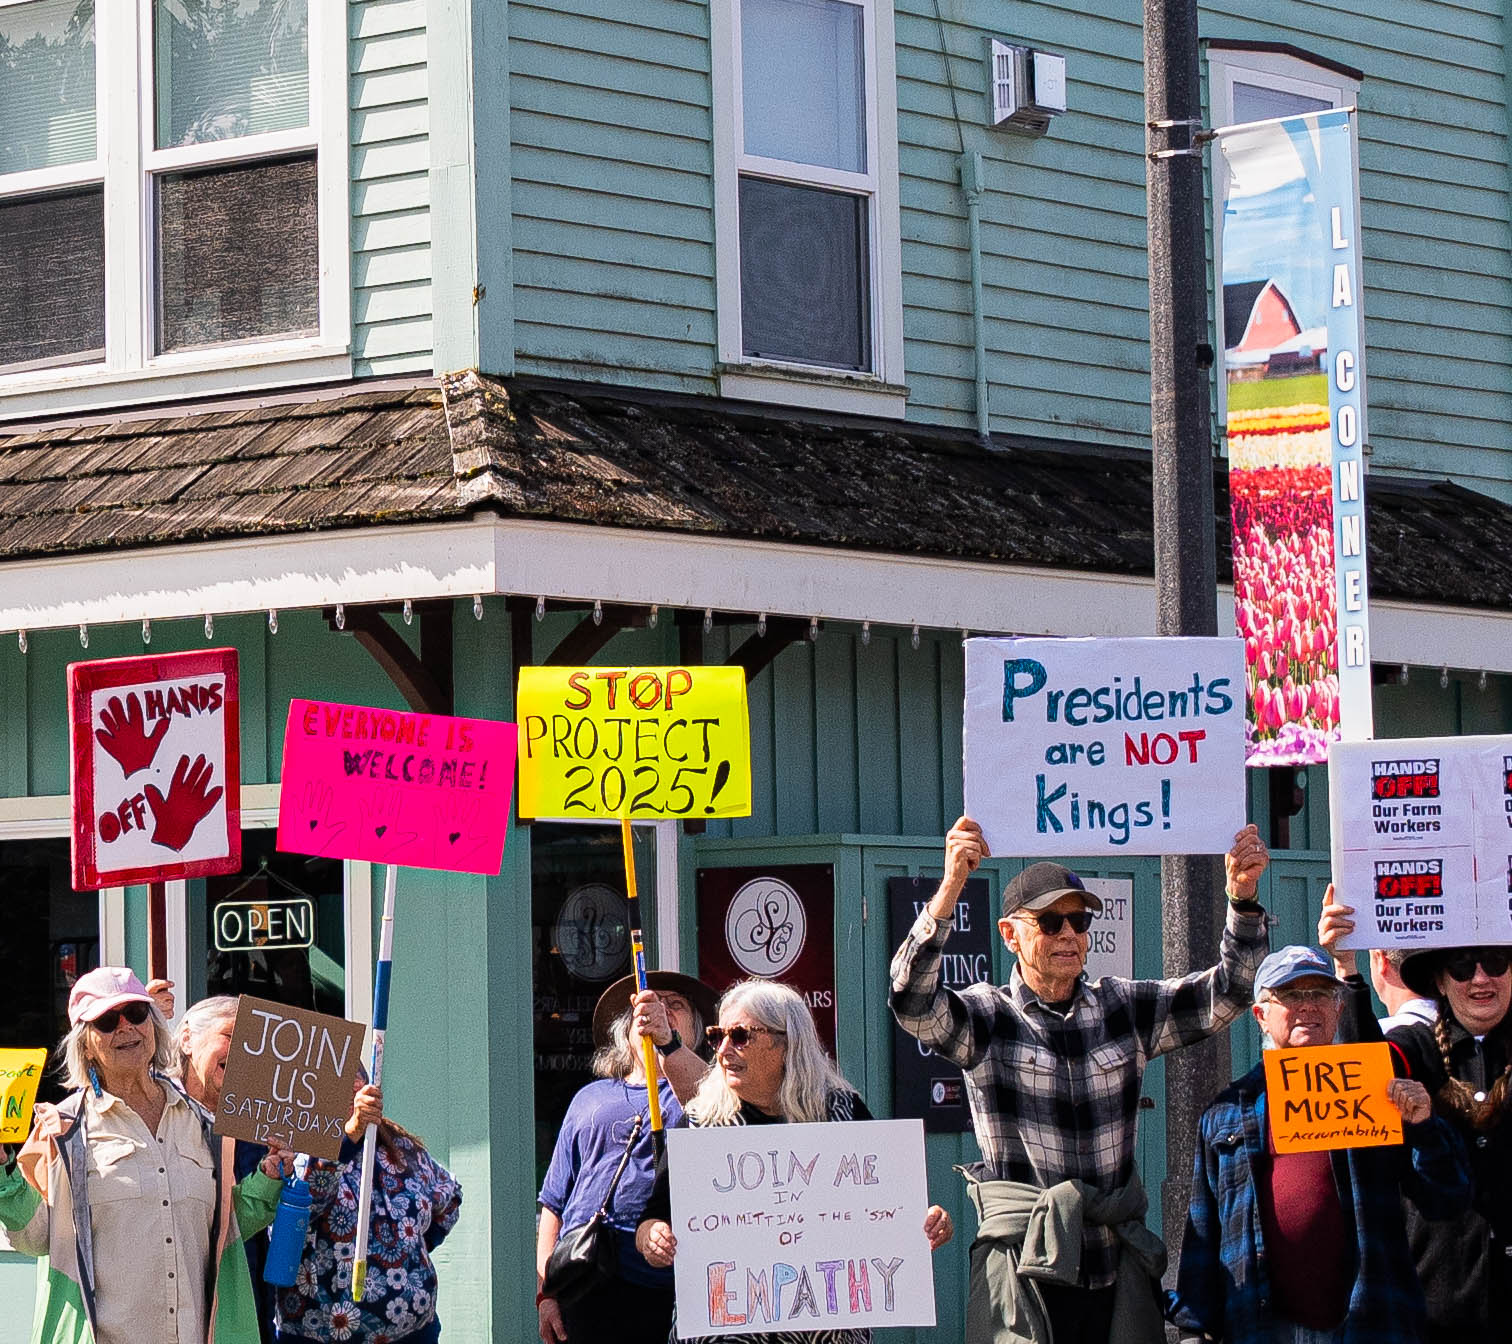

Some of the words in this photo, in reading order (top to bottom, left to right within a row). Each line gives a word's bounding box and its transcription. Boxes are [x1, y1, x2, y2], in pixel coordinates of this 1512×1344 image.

[1331, 207, 1352, 308] LA
[1336, 350, 1365, 666] CONNER
[144, 682, 223, 720] HANDS
[564, 670, 692, 711] STOP
[1002, 658, 1233, 726] Presidents
[303, 705, 431, 747] EVERYONE
[446, 722, 473, 752] IS
[526, 715, 719, 763] PROJECT
[1045, 741, 1105, 766] are
[1125, 730, 1206, 766] NOT
[343, 750, 488, 789] WELCOME!
[564, 760, 730, 814] 2025!
[1374, 761, 1437, 775] HANDS
[1376, 776, 1439, 797] OFF!
[99, 793, 145, 843] OFF
[1035, 774, 1171, 845] Kings!
[1373, 804, 1399, 817] Our
[1403, 804, 1441, 817] Farm
[1375, 819, 1440, 834] Workers
[1377, 861, 1440, 875] HANDS
[1378, 876, 1441, 897] OFF!
[221, 906, 305, 943] OPEN
[1376, 904, 1401, 917] Our
[1406, 903, 1444, 916] Farm
[1377, 918, 1444, 933] Workers
[243, 1009, 351, 1077] JOIN
[272, 1064, 317, 1109] US
[1280, 1057, 1362, 1094] FIRE
[224, 1093, 343, 1138] SATURDAYS
[1285, 1094, 1375, 1123] MUSK
[713, 1150, 820, 1192] JOIN
[834, 1153, 879, 1187] ME
[774, 1191, 803, 1204] IN
[688, 1212, 804, 1232] COMMITTING
[819, 1212, 851, 1222] THE
[779, 1231, 803, 1245] OF
[707, 1257, 904, 1327] EMPATHY
